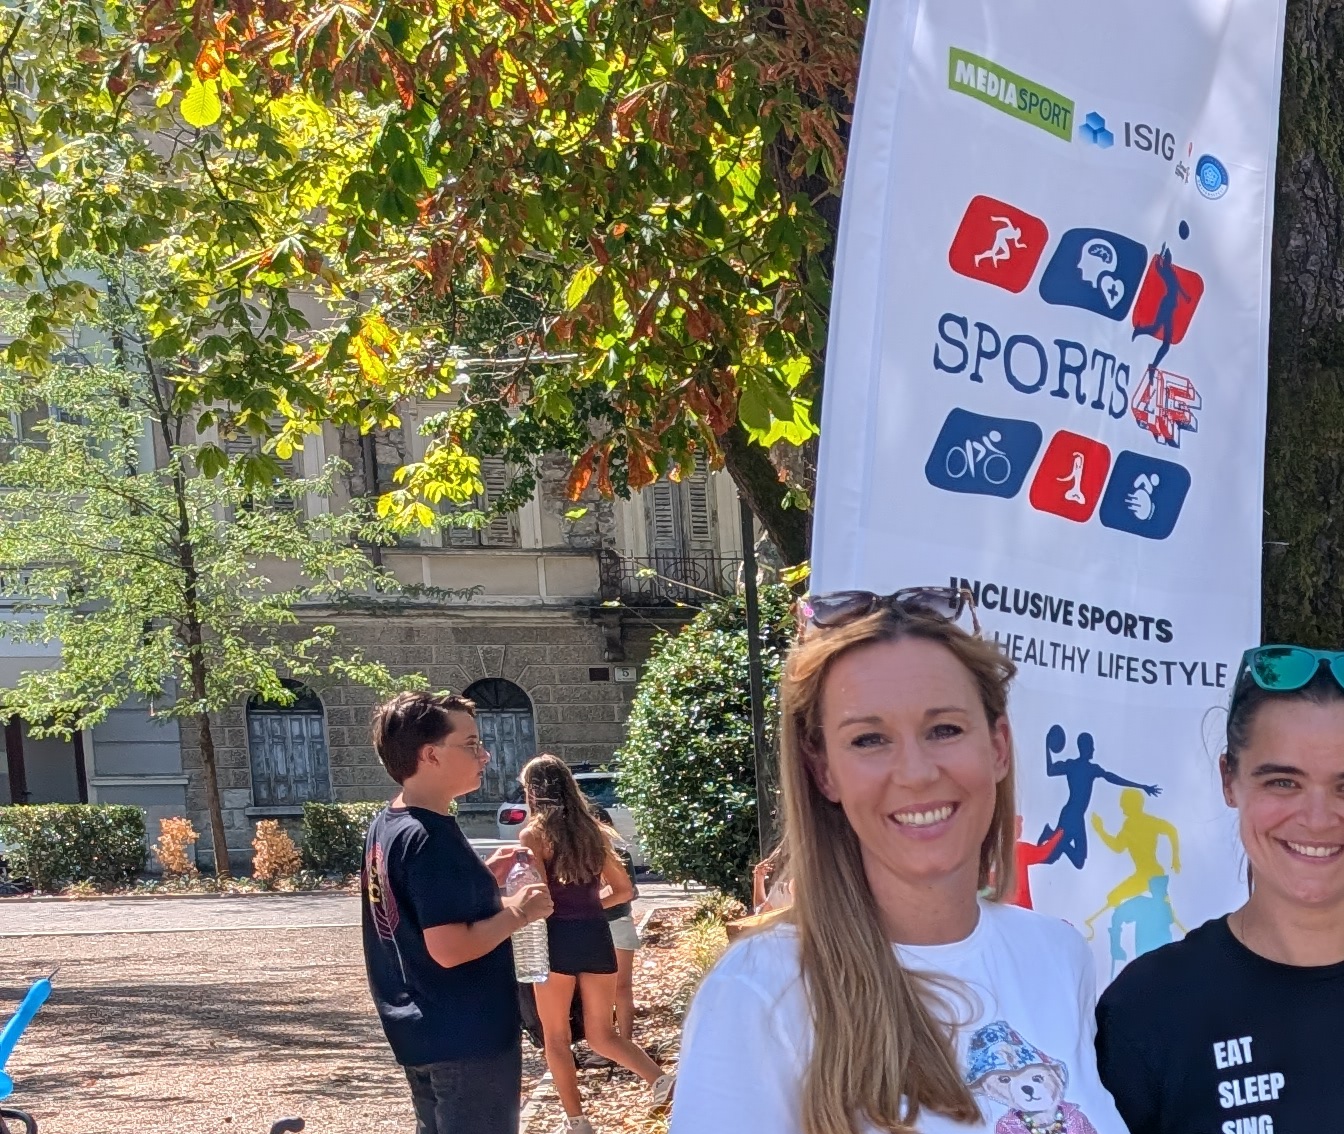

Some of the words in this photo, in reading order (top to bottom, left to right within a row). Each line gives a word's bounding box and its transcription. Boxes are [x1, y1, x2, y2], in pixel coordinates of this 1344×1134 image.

[955, 59, 1072, 132] MEDIASPORT
[1124, 121, 1176, 162] ISIG
[934, 312, 1130, 420] SPORTS
[1077, 602, 1174, 643] SPORTS
[1097, 650, 1228, 688] LIFESTYLE
[1213, 1035, 1253, 1070] EAT
[1217, 1072, 1286, 1109] SLEEP
